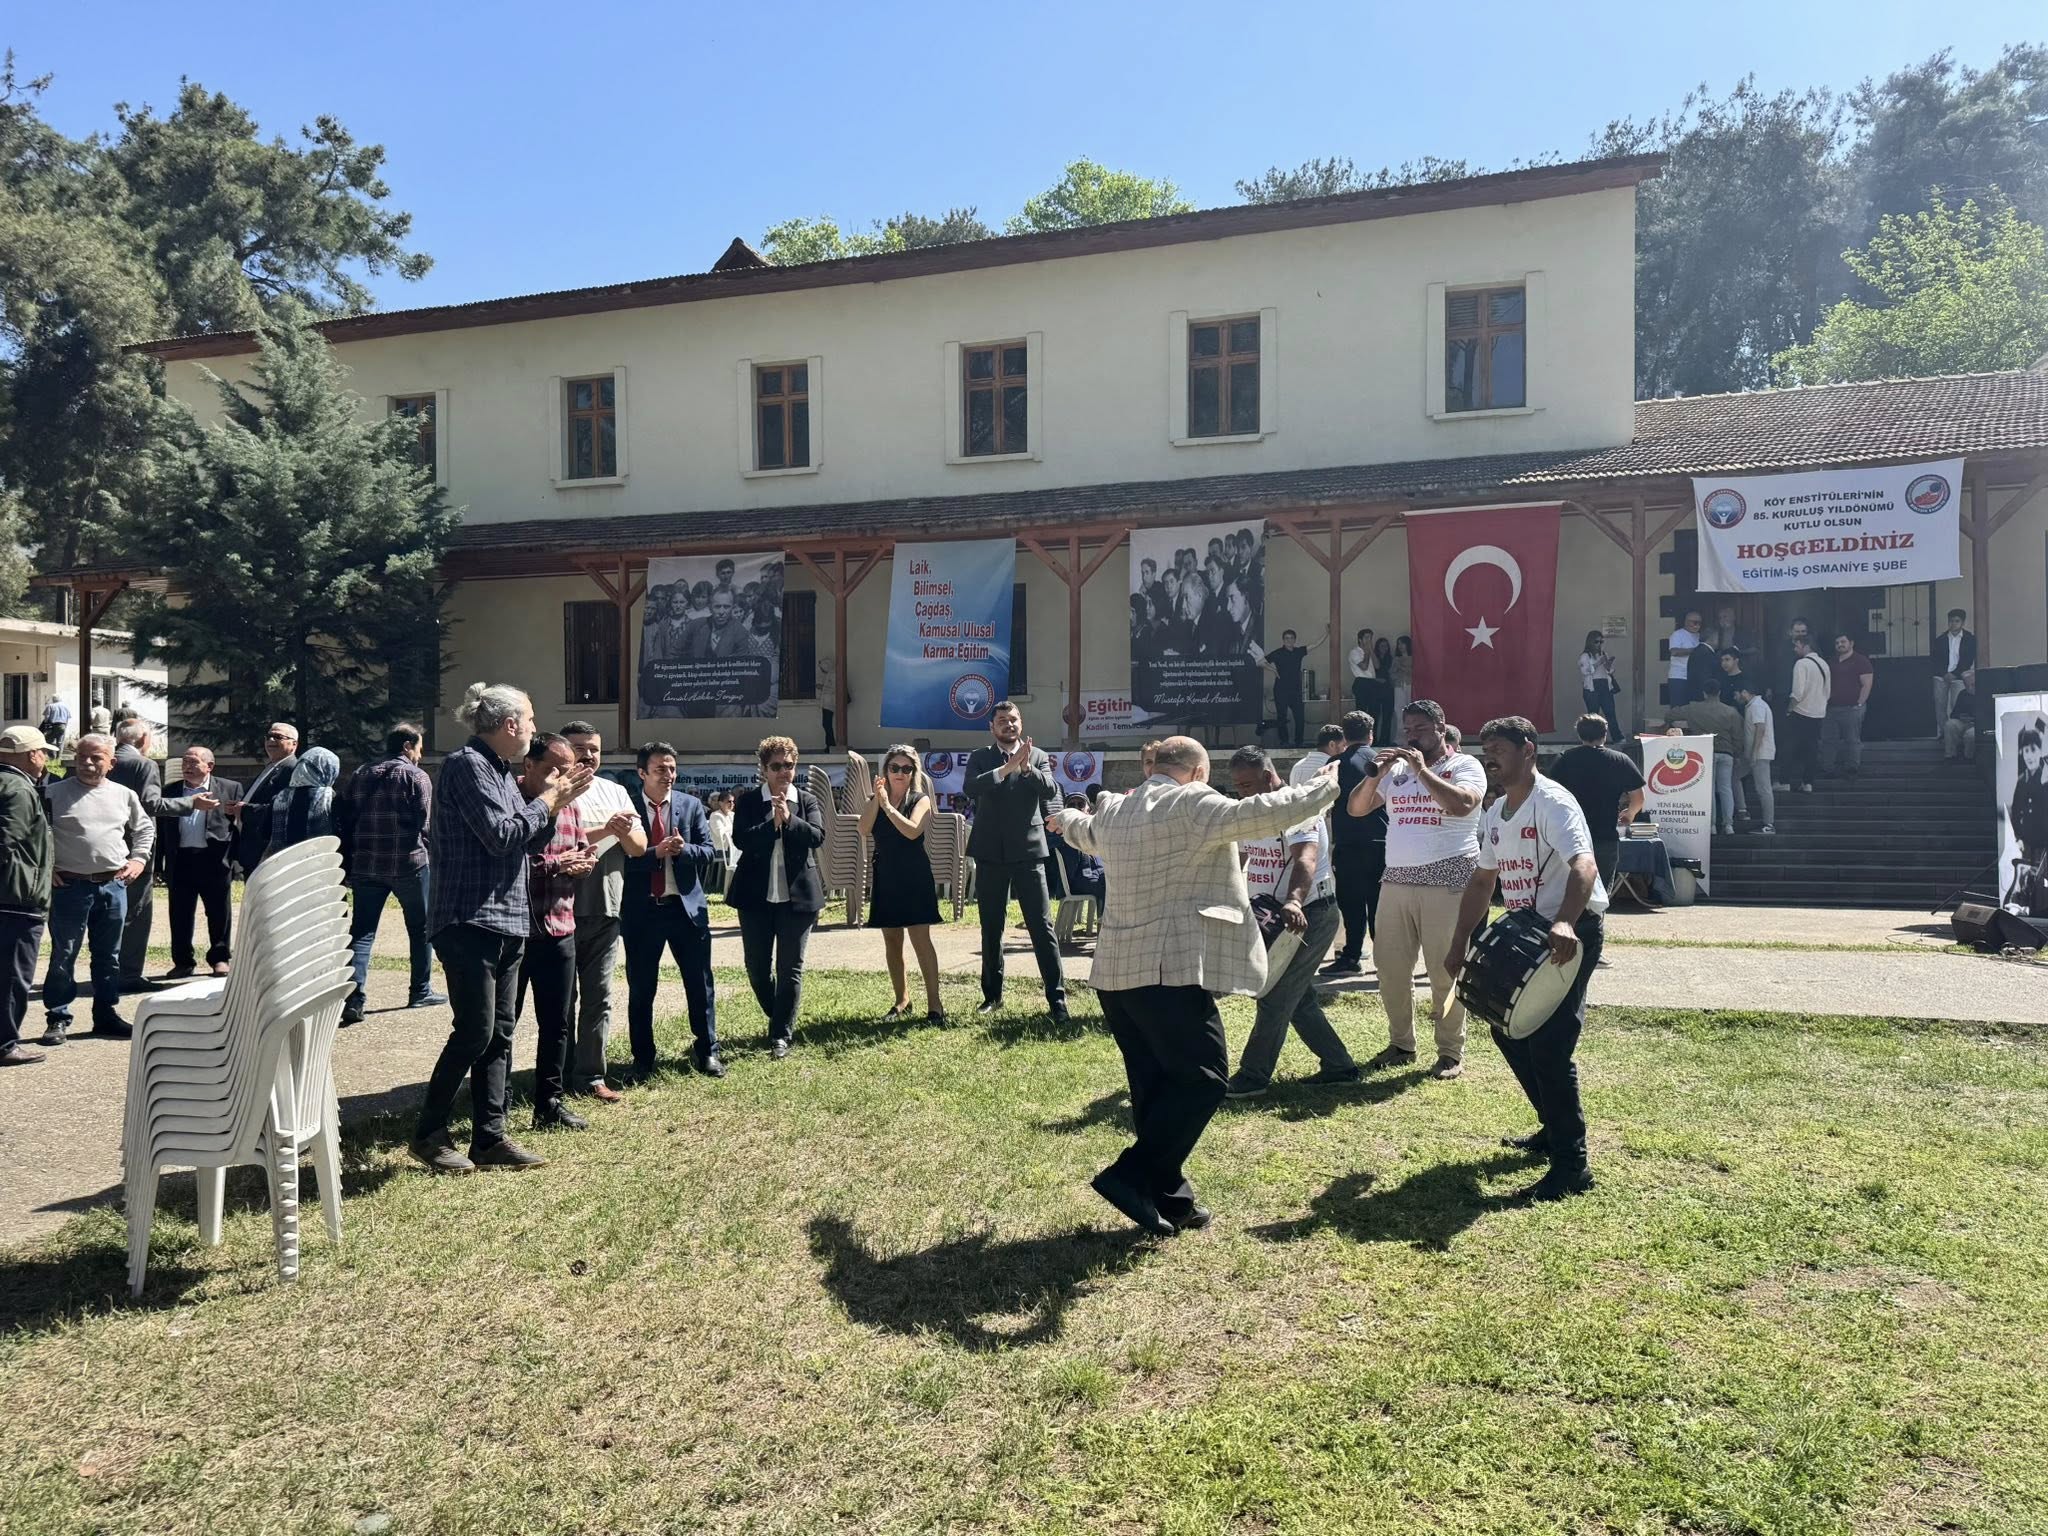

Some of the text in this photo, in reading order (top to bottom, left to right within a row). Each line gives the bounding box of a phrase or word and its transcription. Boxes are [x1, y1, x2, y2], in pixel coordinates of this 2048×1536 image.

[1764, 490, 1884, 507] KÖY ENSTİTÜLERİ'NİN
[1753, 501, 1895, 521] 85. KURULUŞ YILDÖNÜMÜ
[1784, 517, 1862, 531] KUTLU OLSUN
[1737, 530, 1914, 561] HOŞGELDİNİZ
[909, 559, 932, 577] Laik,
[1742, 560, 1908, 579] EĞİTİM-İŞ OSMANİYE ŞUBE
[913, 580, 954, 597] Bilimsel,
[915, 601, 953, 621] Çağdaş,
[919, 621, 995, 638] Kamusal Ulusal
[923, 643, 989, 662] Karma Eğitim
[722, 774, 749, 784] bütün
